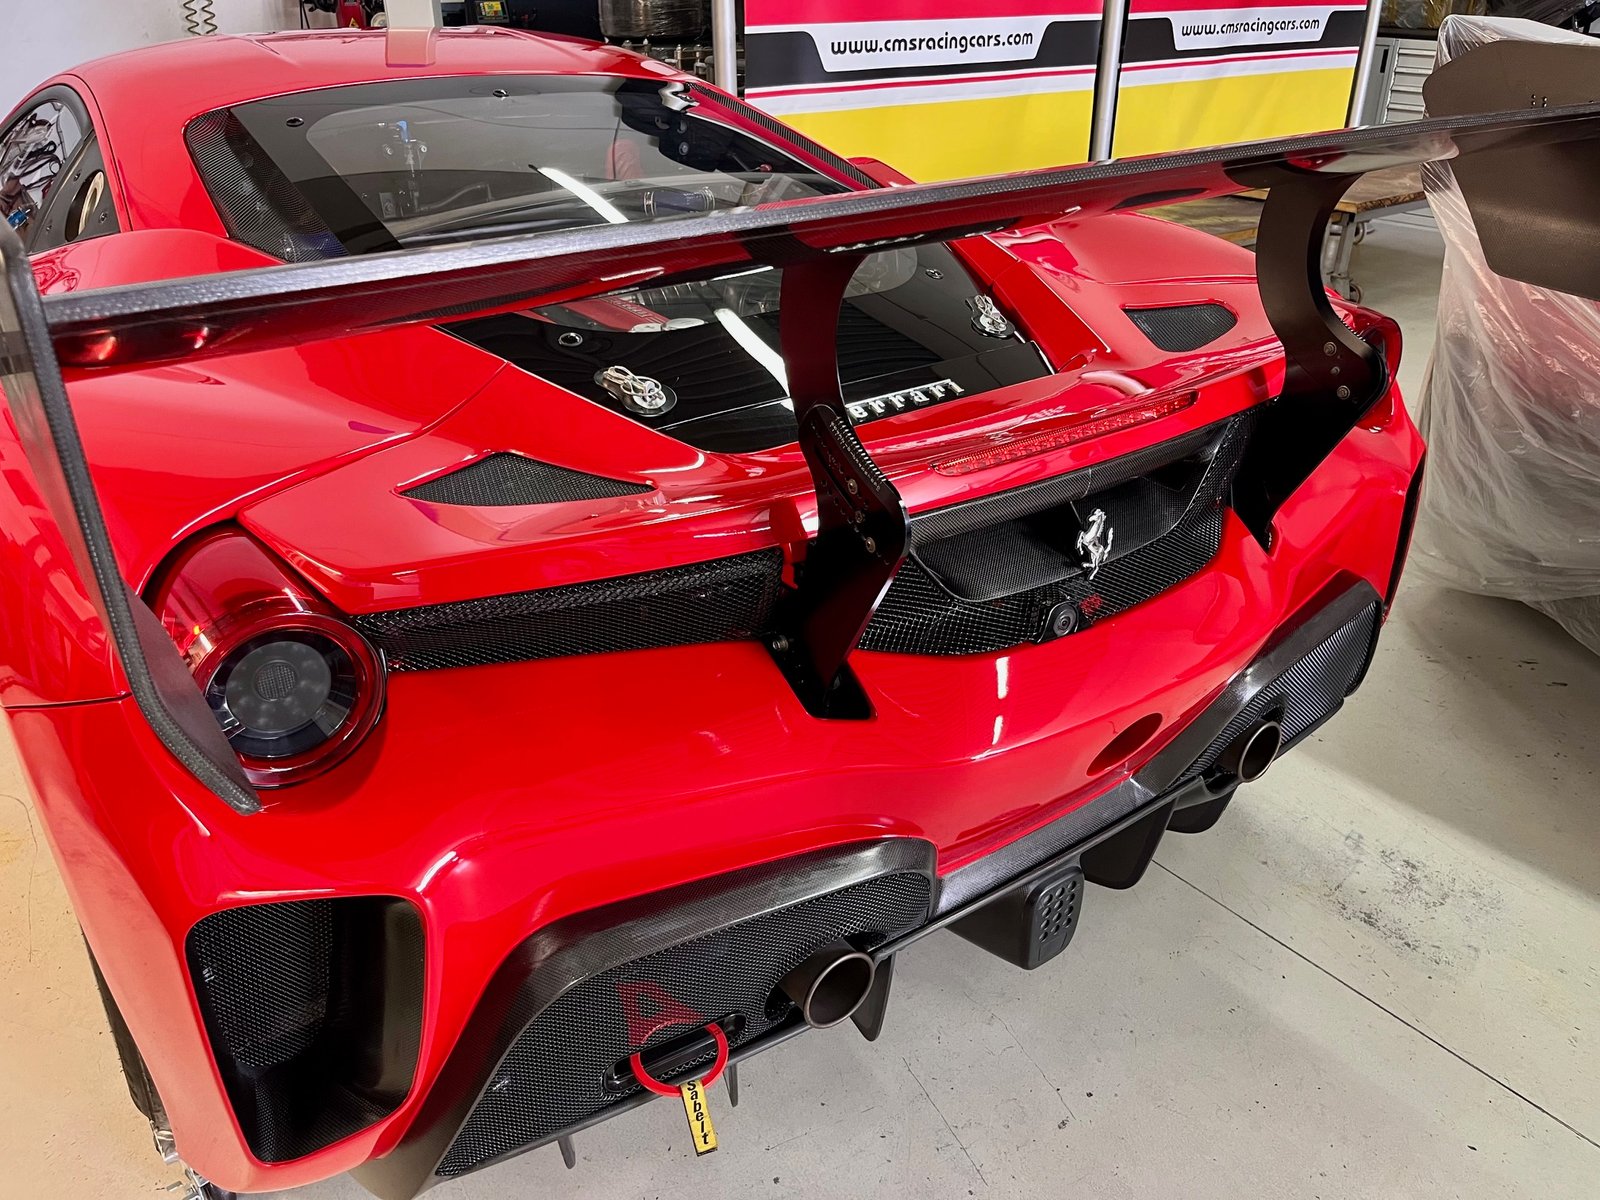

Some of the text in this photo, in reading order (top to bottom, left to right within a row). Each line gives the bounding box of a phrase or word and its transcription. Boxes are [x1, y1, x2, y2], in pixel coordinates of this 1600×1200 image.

[831, 31, 1034, 55] www.cmsracingcars.com
[1181, 17, 1320, 37] www.cmsracingcars.com
[845, 378, 965, 422] errari
[686, 1079, 709, 1145] Sabelt
